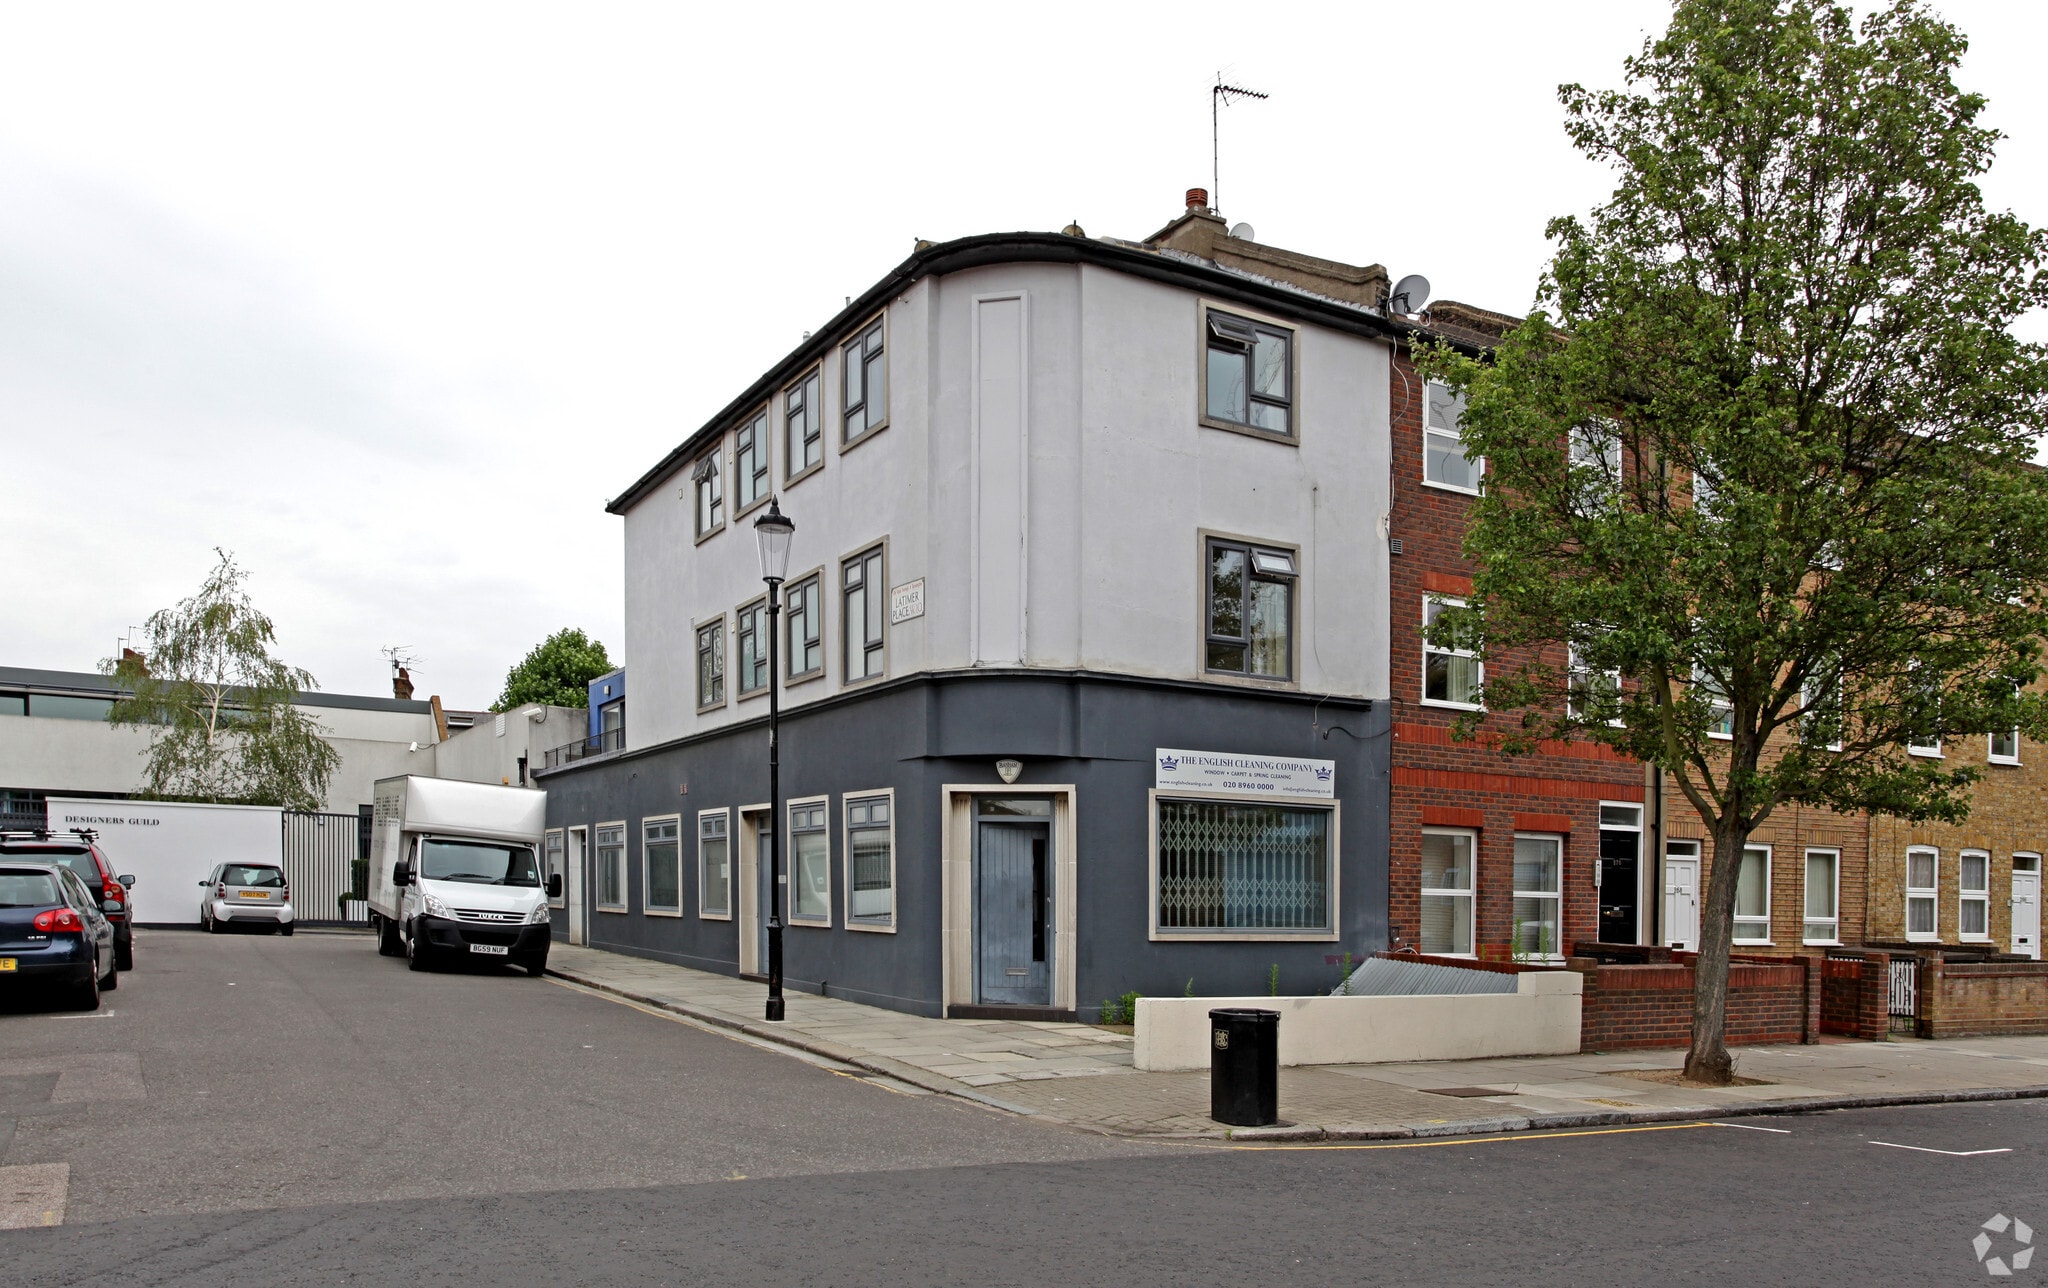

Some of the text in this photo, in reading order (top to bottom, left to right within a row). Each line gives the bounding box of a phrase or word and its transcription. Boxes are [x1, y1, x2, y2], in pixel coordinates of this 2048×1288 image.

[895, 591, 919, 609] LATIMER
[893, 605, 910, 620] PLACE
[1180, 755, 1313, 773] THE ENGLISH CLEANING COMPANY
[1238, 782, 1255, 790] 8960
[65, 815, 160, 826] DESIGNERS GUILD
[473, 945, 491, 953] BG59
